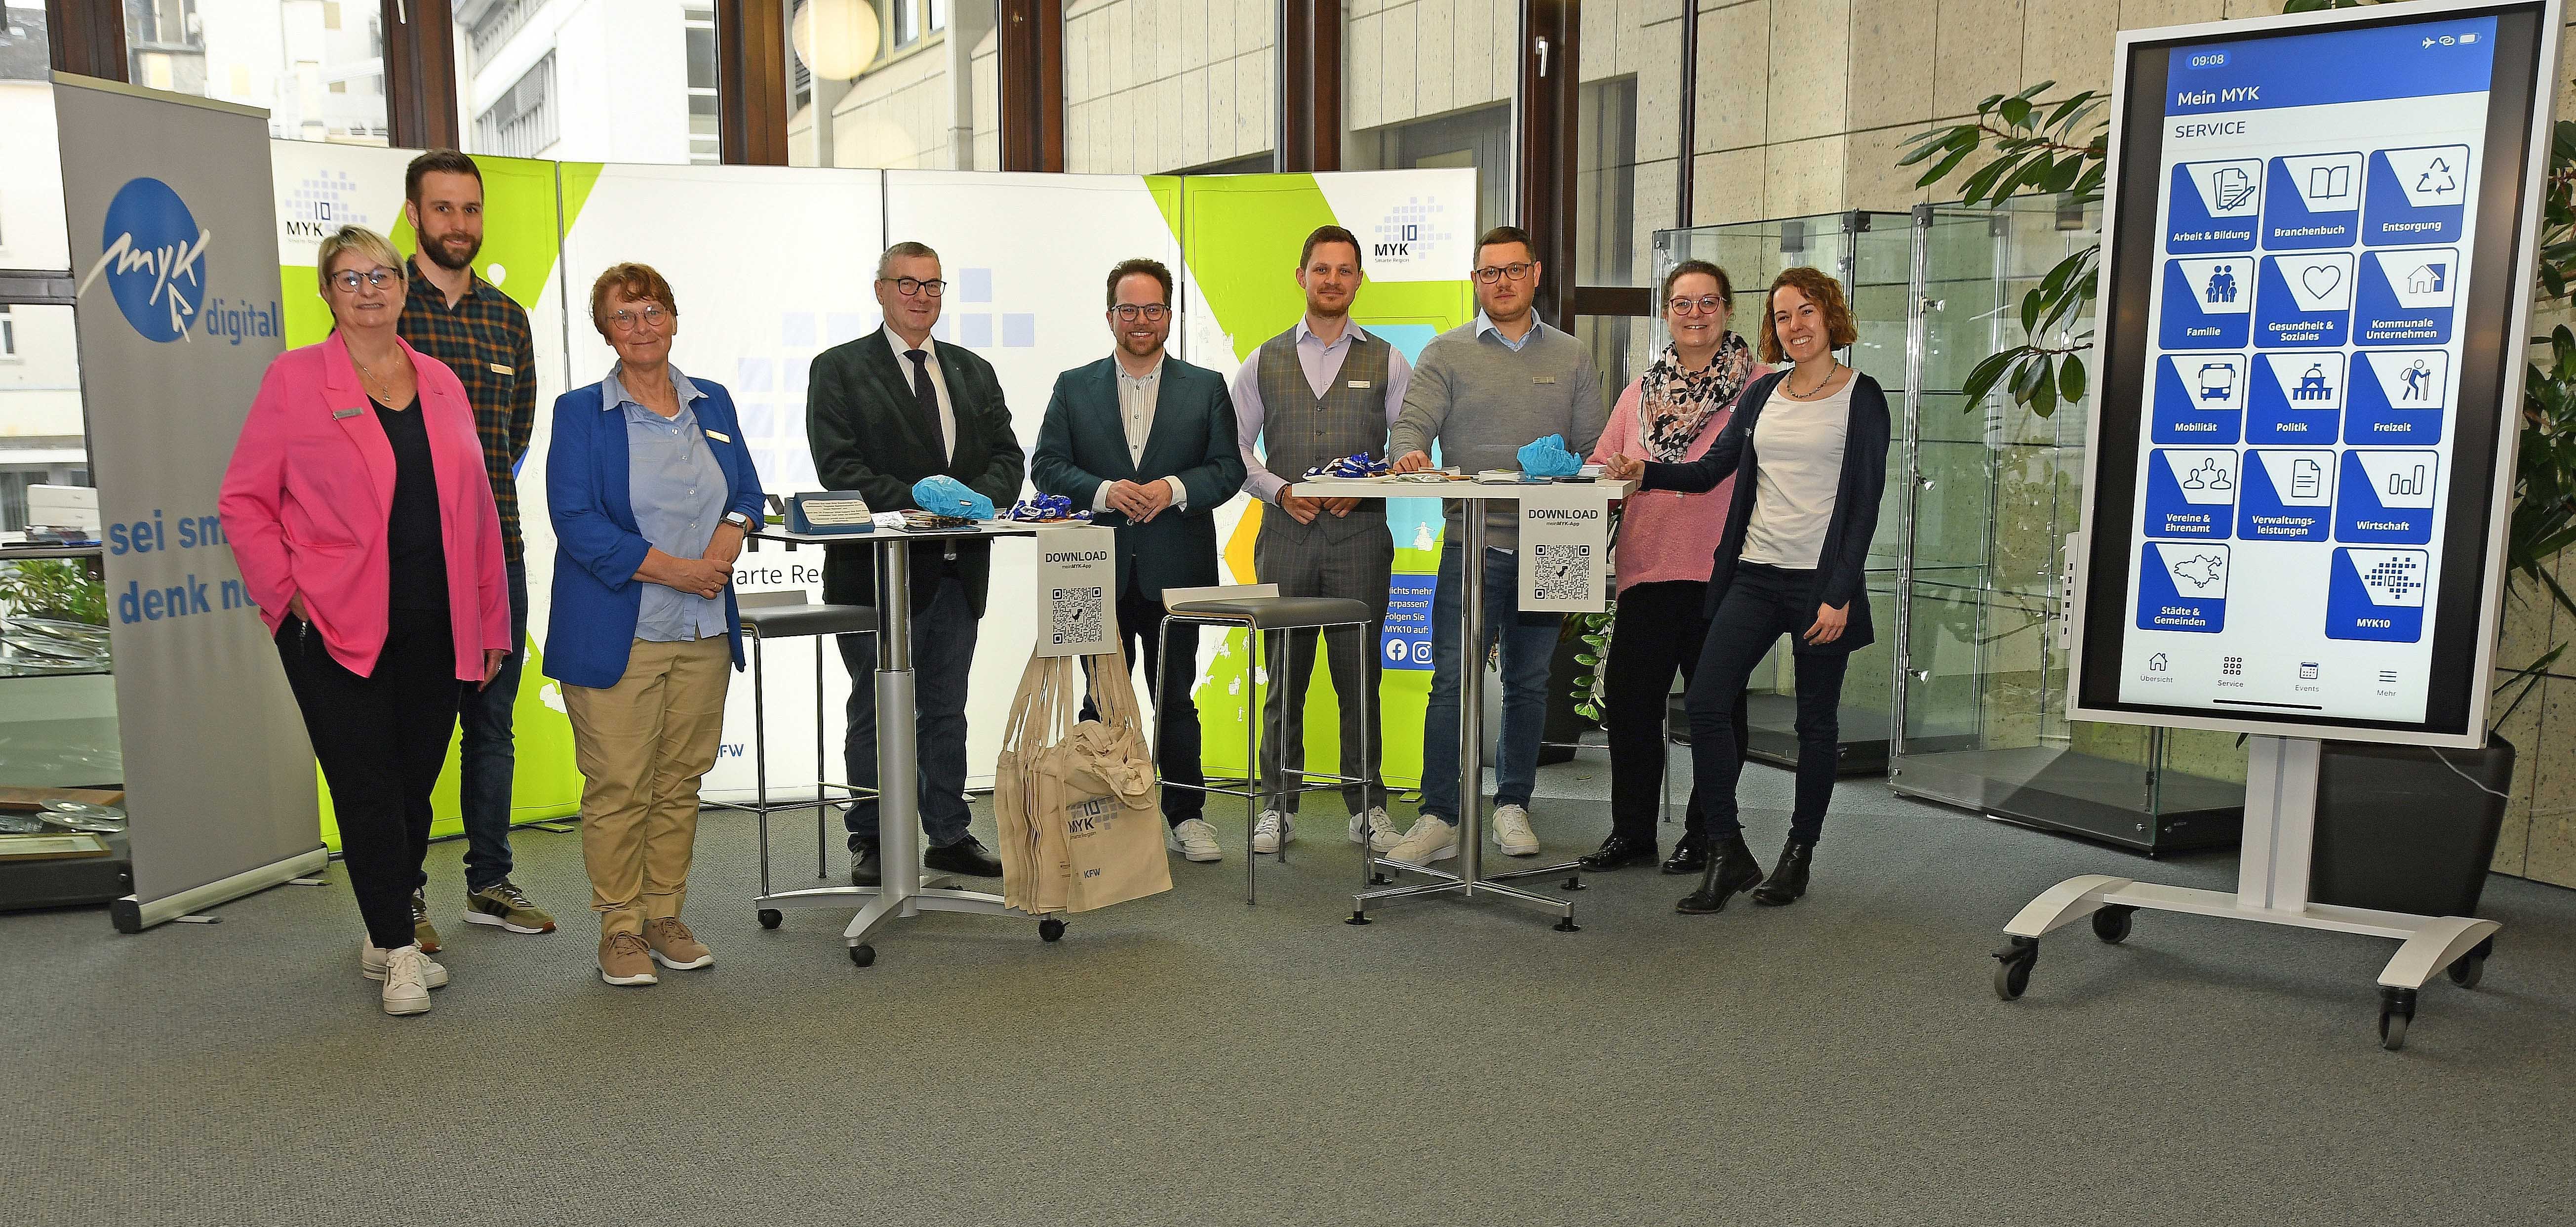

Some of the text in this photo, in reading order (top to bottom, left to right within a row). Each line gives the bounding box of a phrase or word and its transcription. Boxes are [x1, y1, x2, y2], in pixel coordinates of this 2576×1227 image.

[2192, 54, 2224, 66] 09:08
[2178, 86, 2259, 106] Mein MYK
[2176, 122, 2245, 138] SERVICE
[287, 221, 324, 237] MYK
[2275, 225, 2344, 237] Branchenbuch
[2383, 222, 2441, 232] Entsorgung
[2173, 231, 2201, 241] Arbeit
[2214, 230, 2250, 241] Bildung
[1375, 243, 1409, 256] MYK
[205, 298, 277, 345] digital
[2269, 321, 2334, 331] Gesundheit &
[2372, 318, 2433, 328] Kommunale
[2187, 327, 2220, 336] Familie
[2280, 331, 2319, 341] Soziales
[2367, 328, 2437, 339] Unternehmen
[2277, 423, 2307, 431] Politik
[2374, 423, 2411, 431] Freizeit
[1528, 509, 1598, 519] DOWNLOAD
[2166, 513, 2211, 523] Vereine &
[2252, 515, 2316, 526] Verwaltungs-
[2357, 521, 2409, 530] Wirtschaft
[110, 509, 229, 556] sei sm
[2166, 524, 2210, 532] Ehrenamt
[2257, 525, 2308, 536] leistungen
[1045, 551, 1107, 563] DOWNLOAD
[736, 565, 821, 585] arte Re
[119, 574, 211, 624] denk
[1389, 601, 1429, 609] erpassen?
[2161, 606, 2200, 616] Städte &
[2154, 616, 2206, 626] Gemeinden
[2357, 619, 2390, 628] MYK10
[2140, 675, 2173, 683] Übersicht
[718, 744, 744, 757] FW
[1068, 817, 1095, 833] MYK
[1083, 868, 1101, 878] KFW
